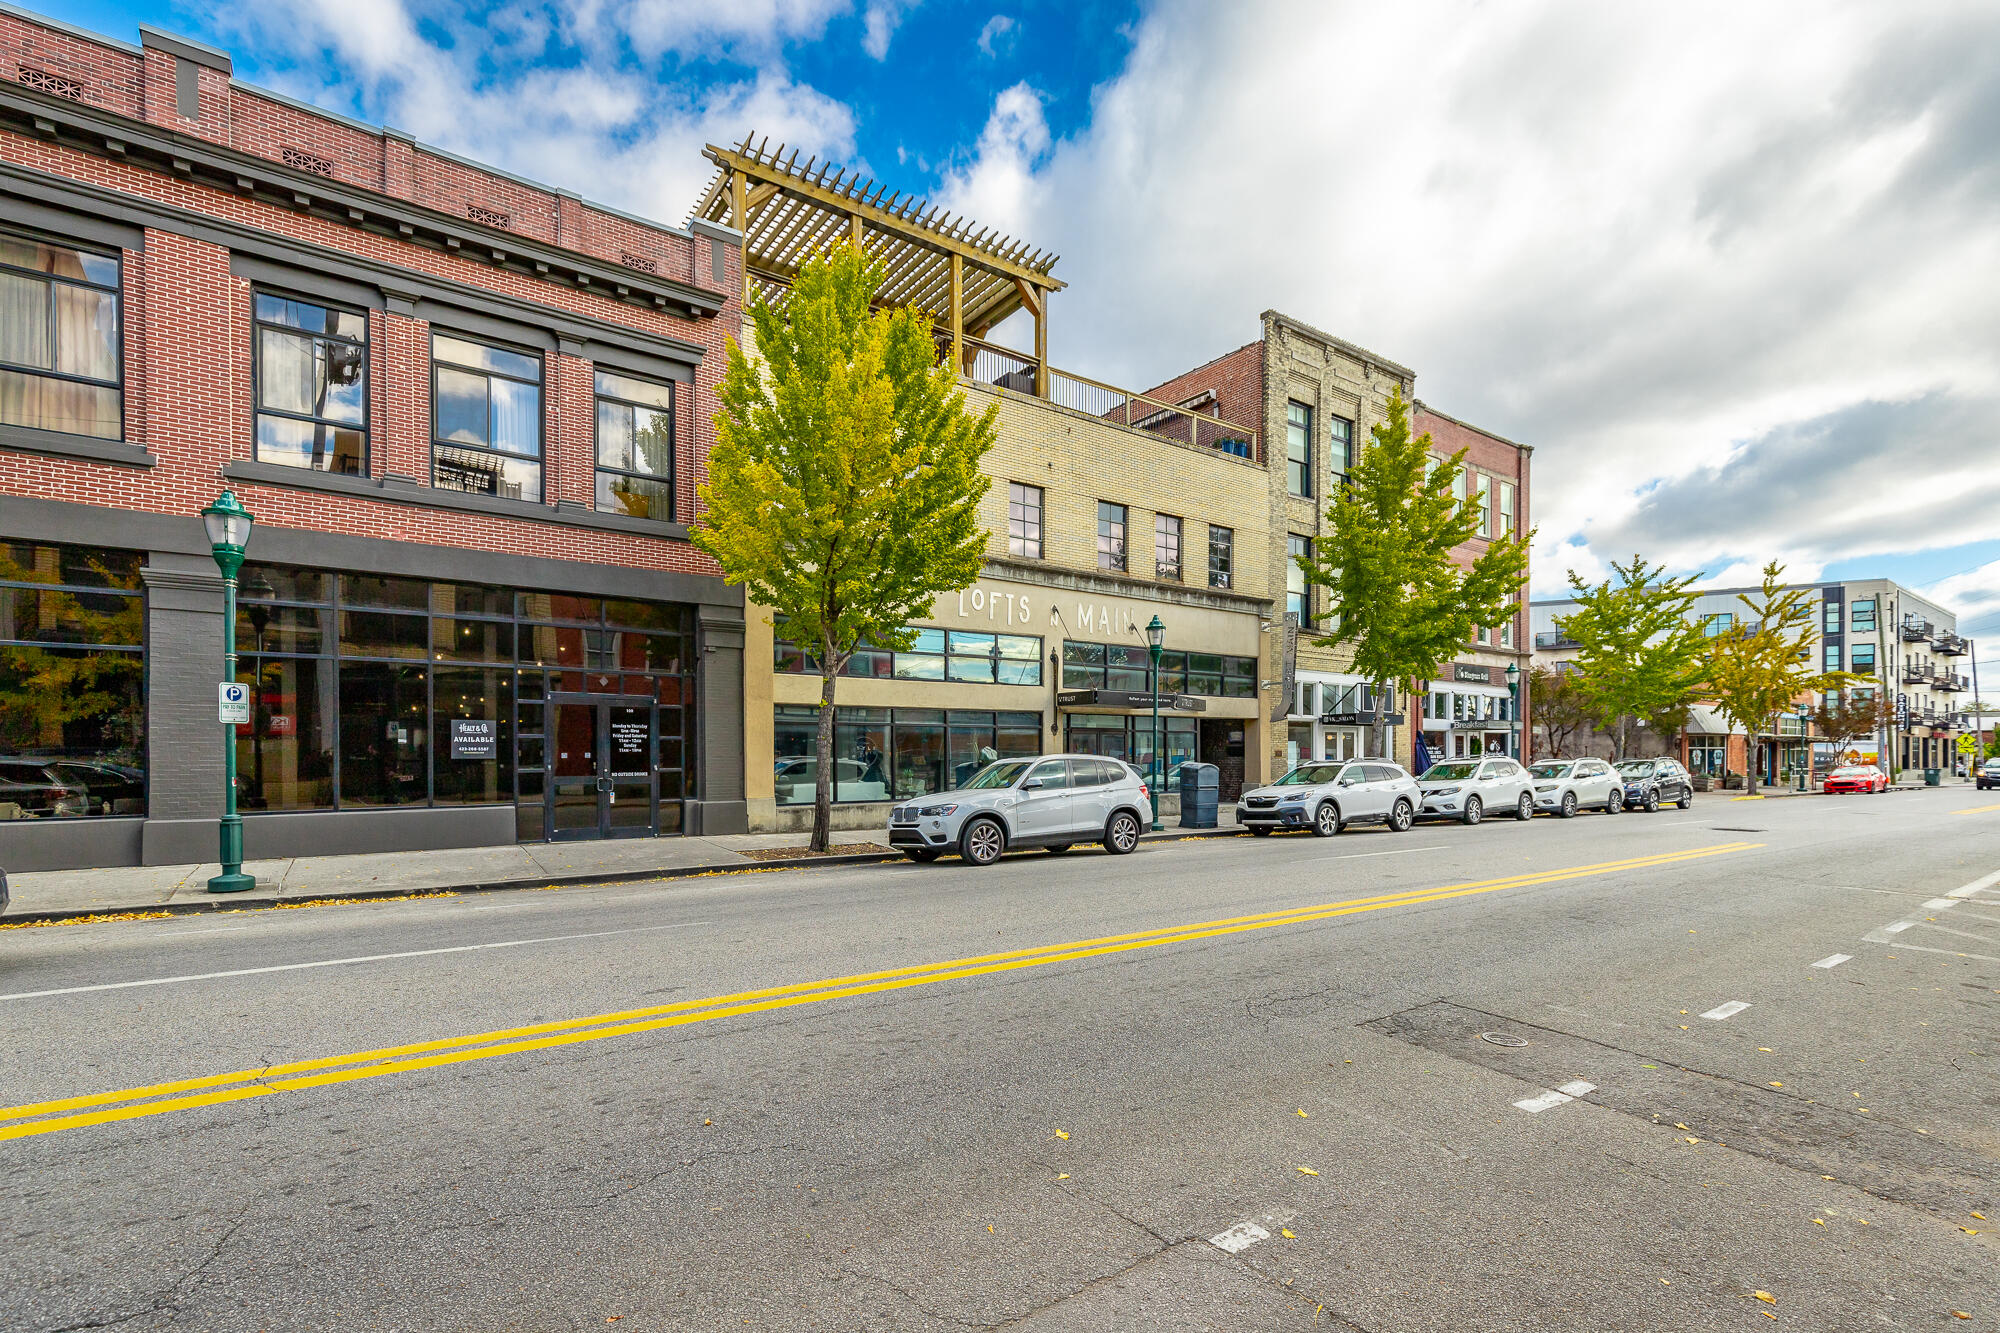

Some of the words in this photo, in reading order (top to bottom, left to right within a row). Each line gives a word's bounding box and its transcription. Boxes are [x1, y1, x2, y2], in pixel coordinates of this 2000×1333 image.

[958, 588, 1030, 625] LOFTS
[1077, 602, 1134, 636] MAIN
[1286, 626, 1295, 654] MAIN
[230, 688, 239, 701] P
[1454, 721, 1488, 729] Breakfast
